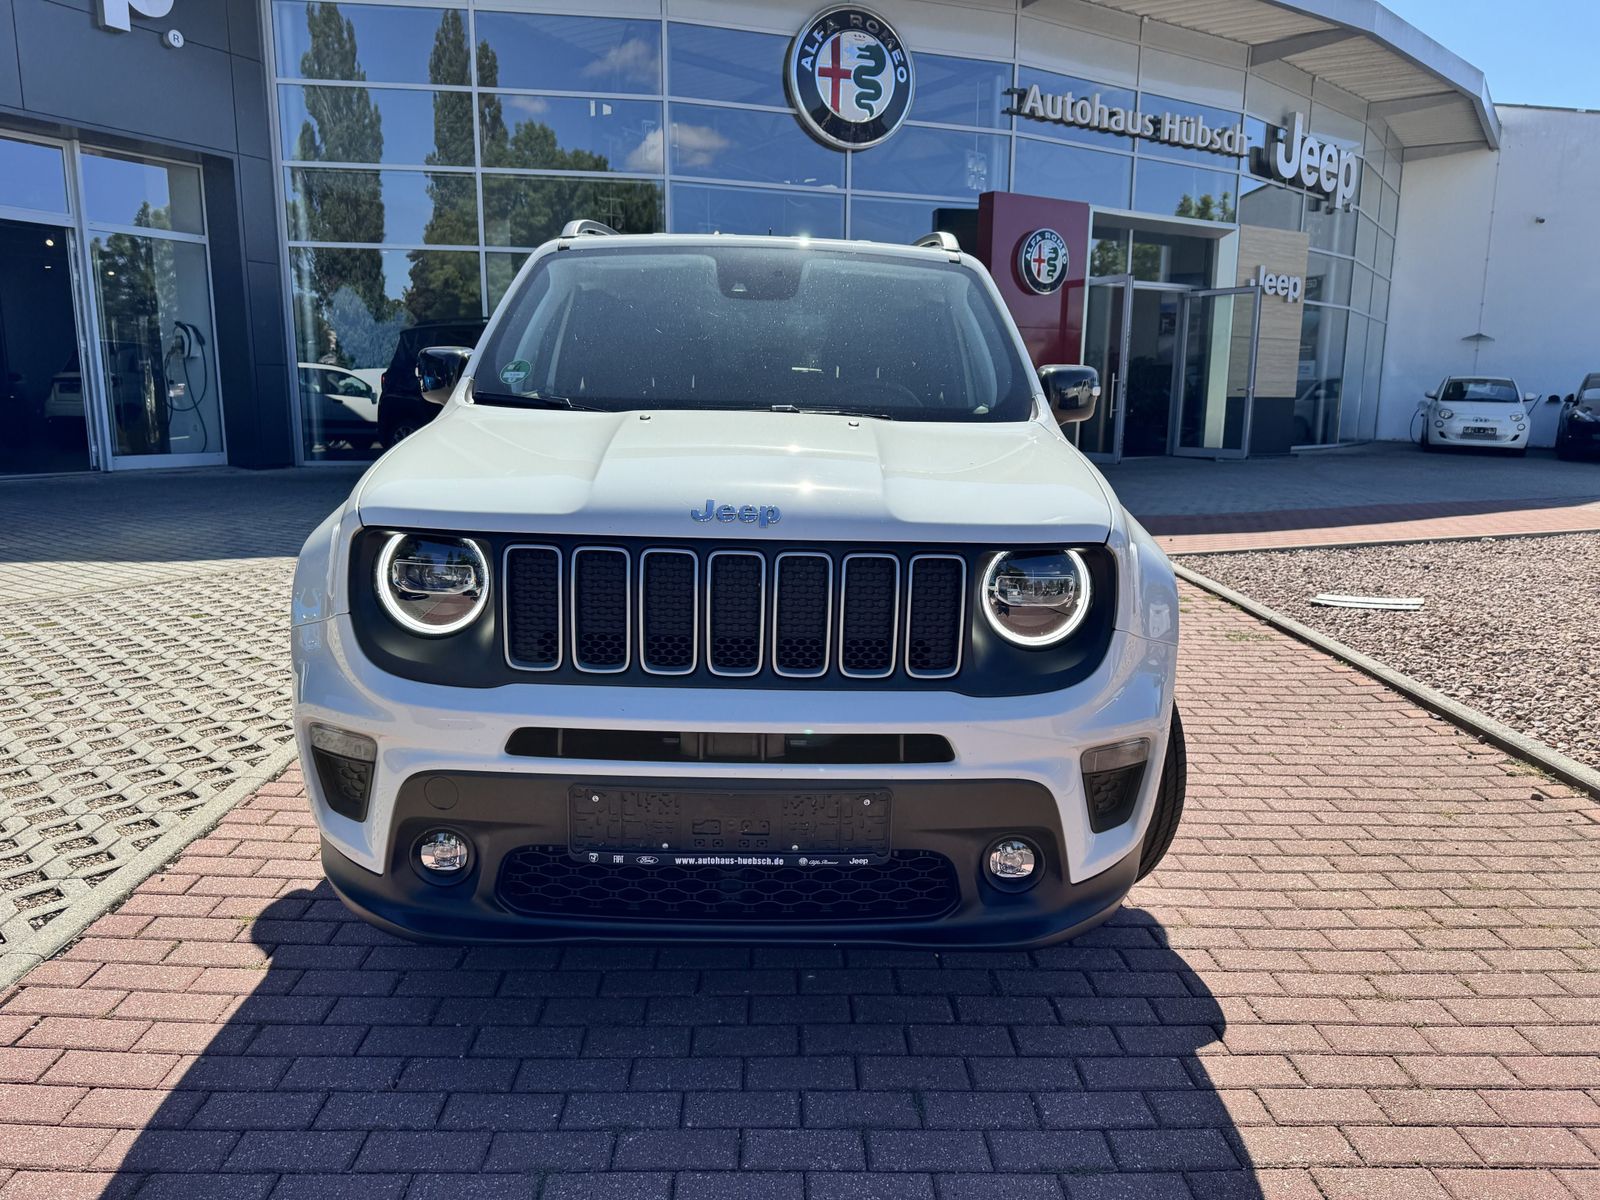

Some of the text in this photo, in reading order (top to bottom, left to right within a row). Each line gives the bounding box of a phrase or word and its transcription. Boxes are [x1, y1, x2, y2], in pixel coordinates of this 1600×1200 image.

[800, 14, 908, 84] ALFA ROMEO
[1021, 83, 1249, 156] Autohaus Hübsch
[1275, 111, 1358, 209] Jeep
[1025, 231, 1068, 265] ALFA ROMEO
[690, 499, 782, 529] Jeep
[674, 856, 785, 866] www.autohaus-huebsch.de
[849, 857, 869, 865] Jeep
